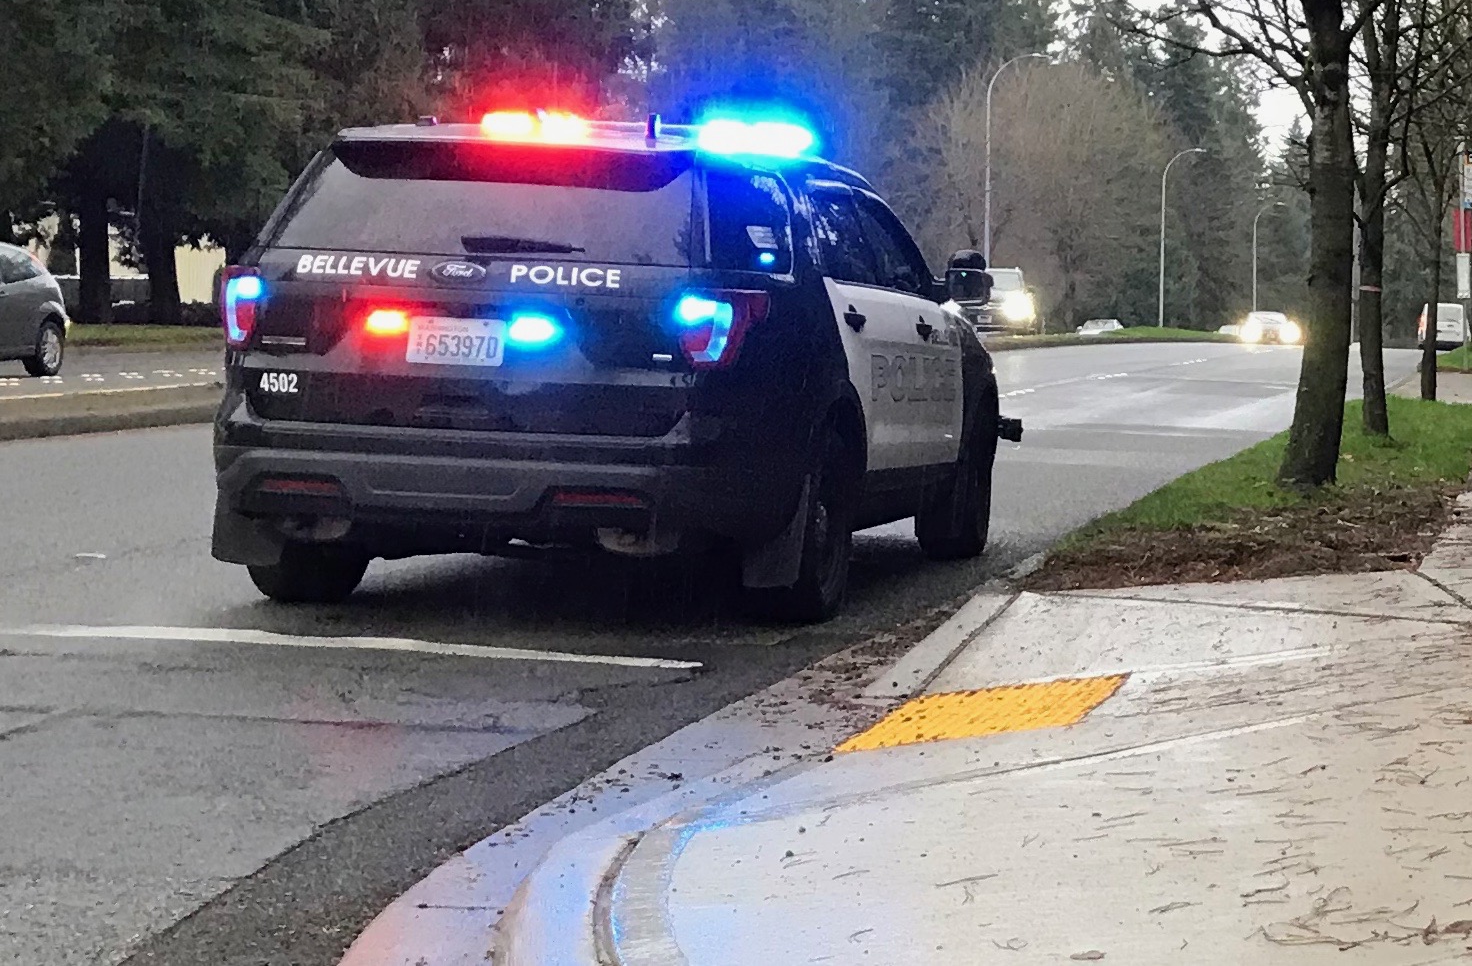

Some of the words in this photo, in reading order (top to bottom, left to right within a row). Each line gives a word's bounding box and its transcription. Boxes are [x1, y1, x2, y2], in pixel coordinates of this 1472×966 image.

[296, 254, 421, 279] BELLEVUE
[510, 264, 621, 288] POLICE
[442, 264, 473, 278] Ford
[260, 372, 299, 393] 4502
[871, 353, 956, 402] POLICE
